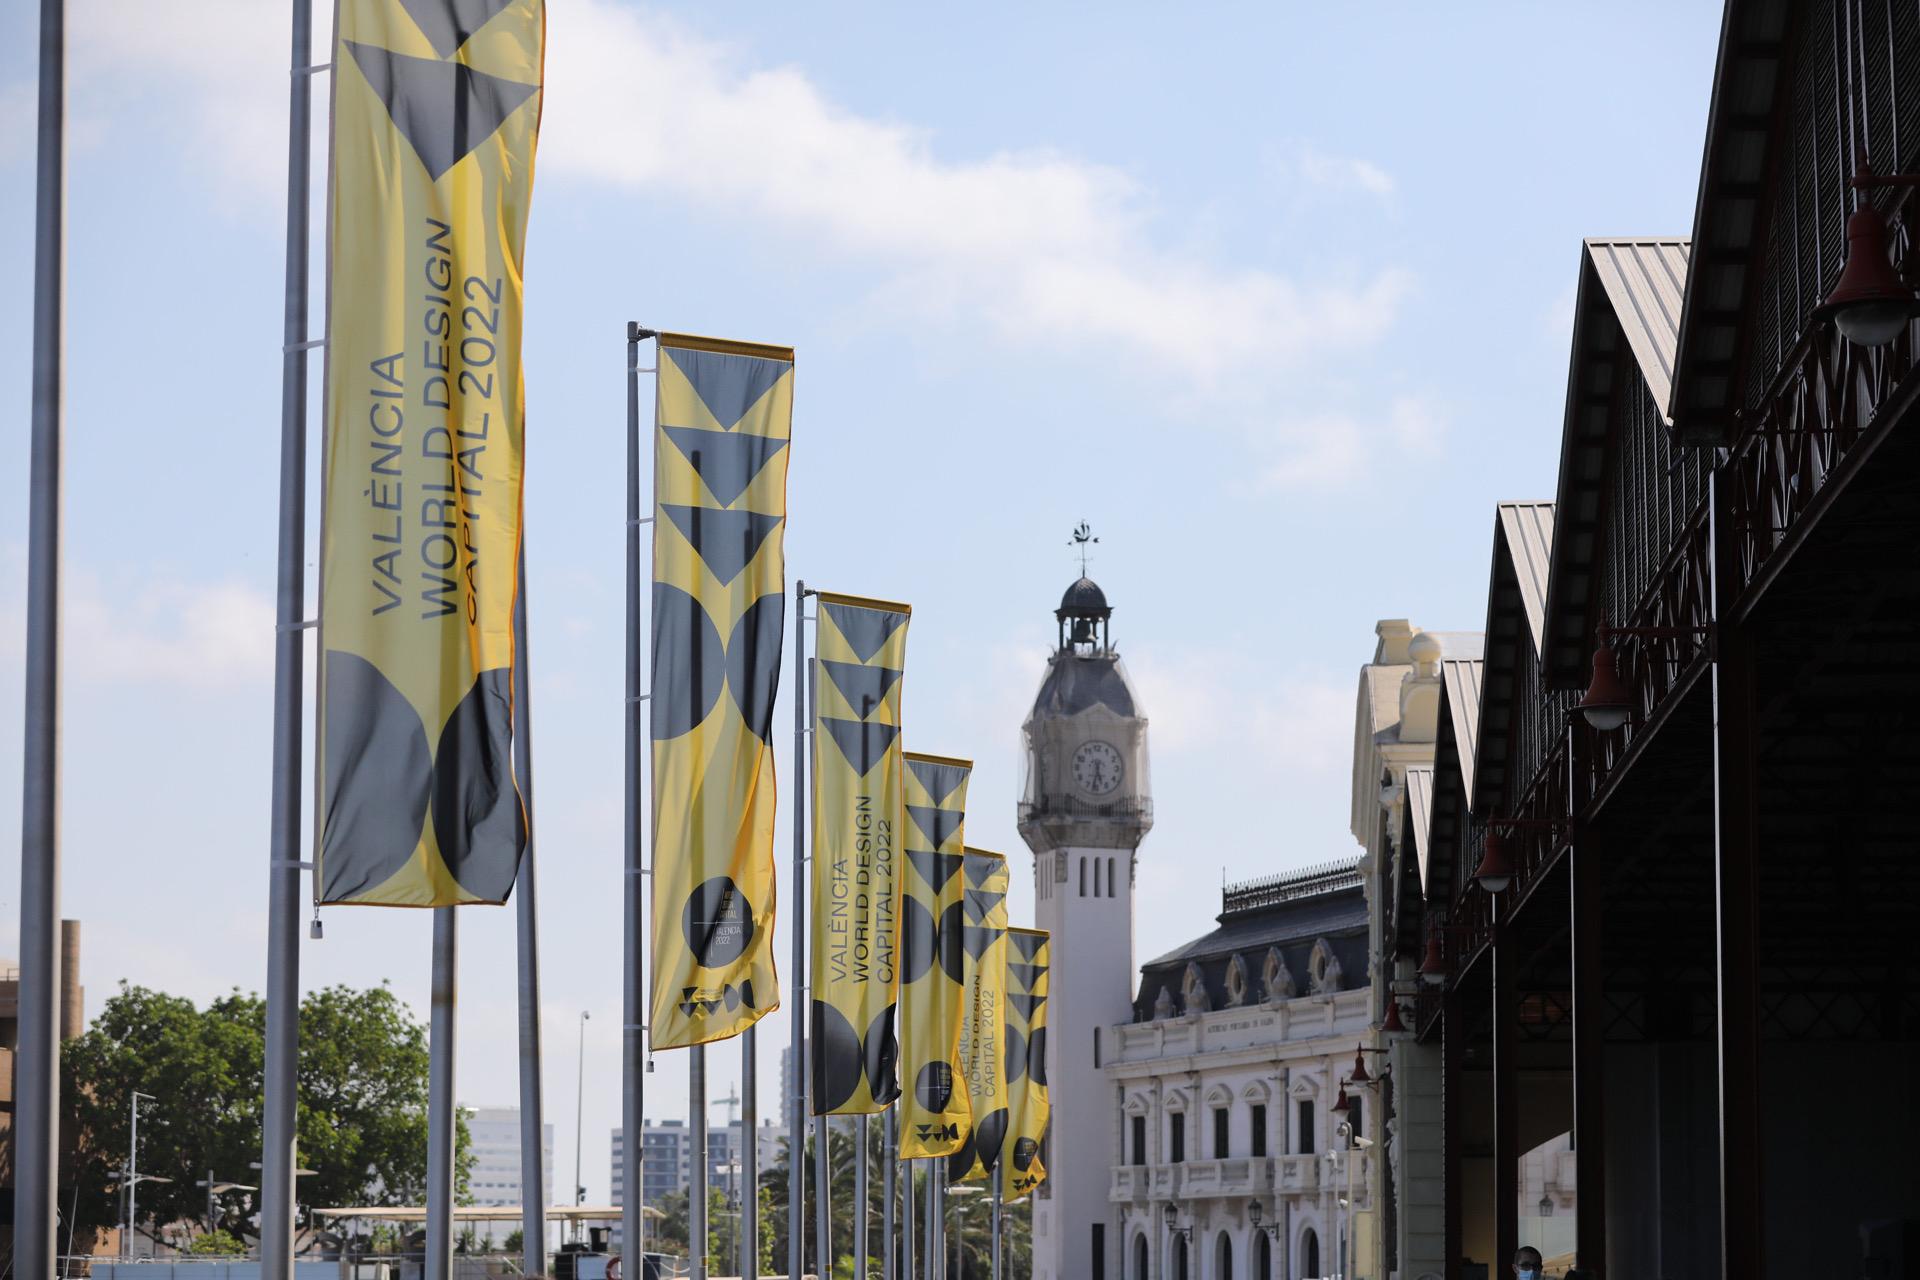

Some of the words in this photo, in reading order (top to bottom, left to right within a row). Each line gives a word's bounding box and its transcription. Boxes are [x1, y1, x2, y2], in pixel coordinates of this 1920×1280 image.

[424, 217, 452, 410] DESIGN
[458, 275, 503, 400] 2022
[364, 352, 405, 616] VALÈNCIA
[421, 429, 458, 620] WORLD
[457, 413, 490, 627] CAPITAL
[856, 796, 872, 886] DESIGN
[876, 819, 891, 877] 2022
[828, 859, 848, 983] VALÈNCIA
[853, 893, 870, 983] WORLD
[876, 883, 894, 984] CAPITAL
[973, 975, 981, 1033] DESIGN
[982, 990, 994, 1027] 2022
[971, 1039, 981, 1096] WORLD
[983, 1031, 995, 1097] CAPITAL
